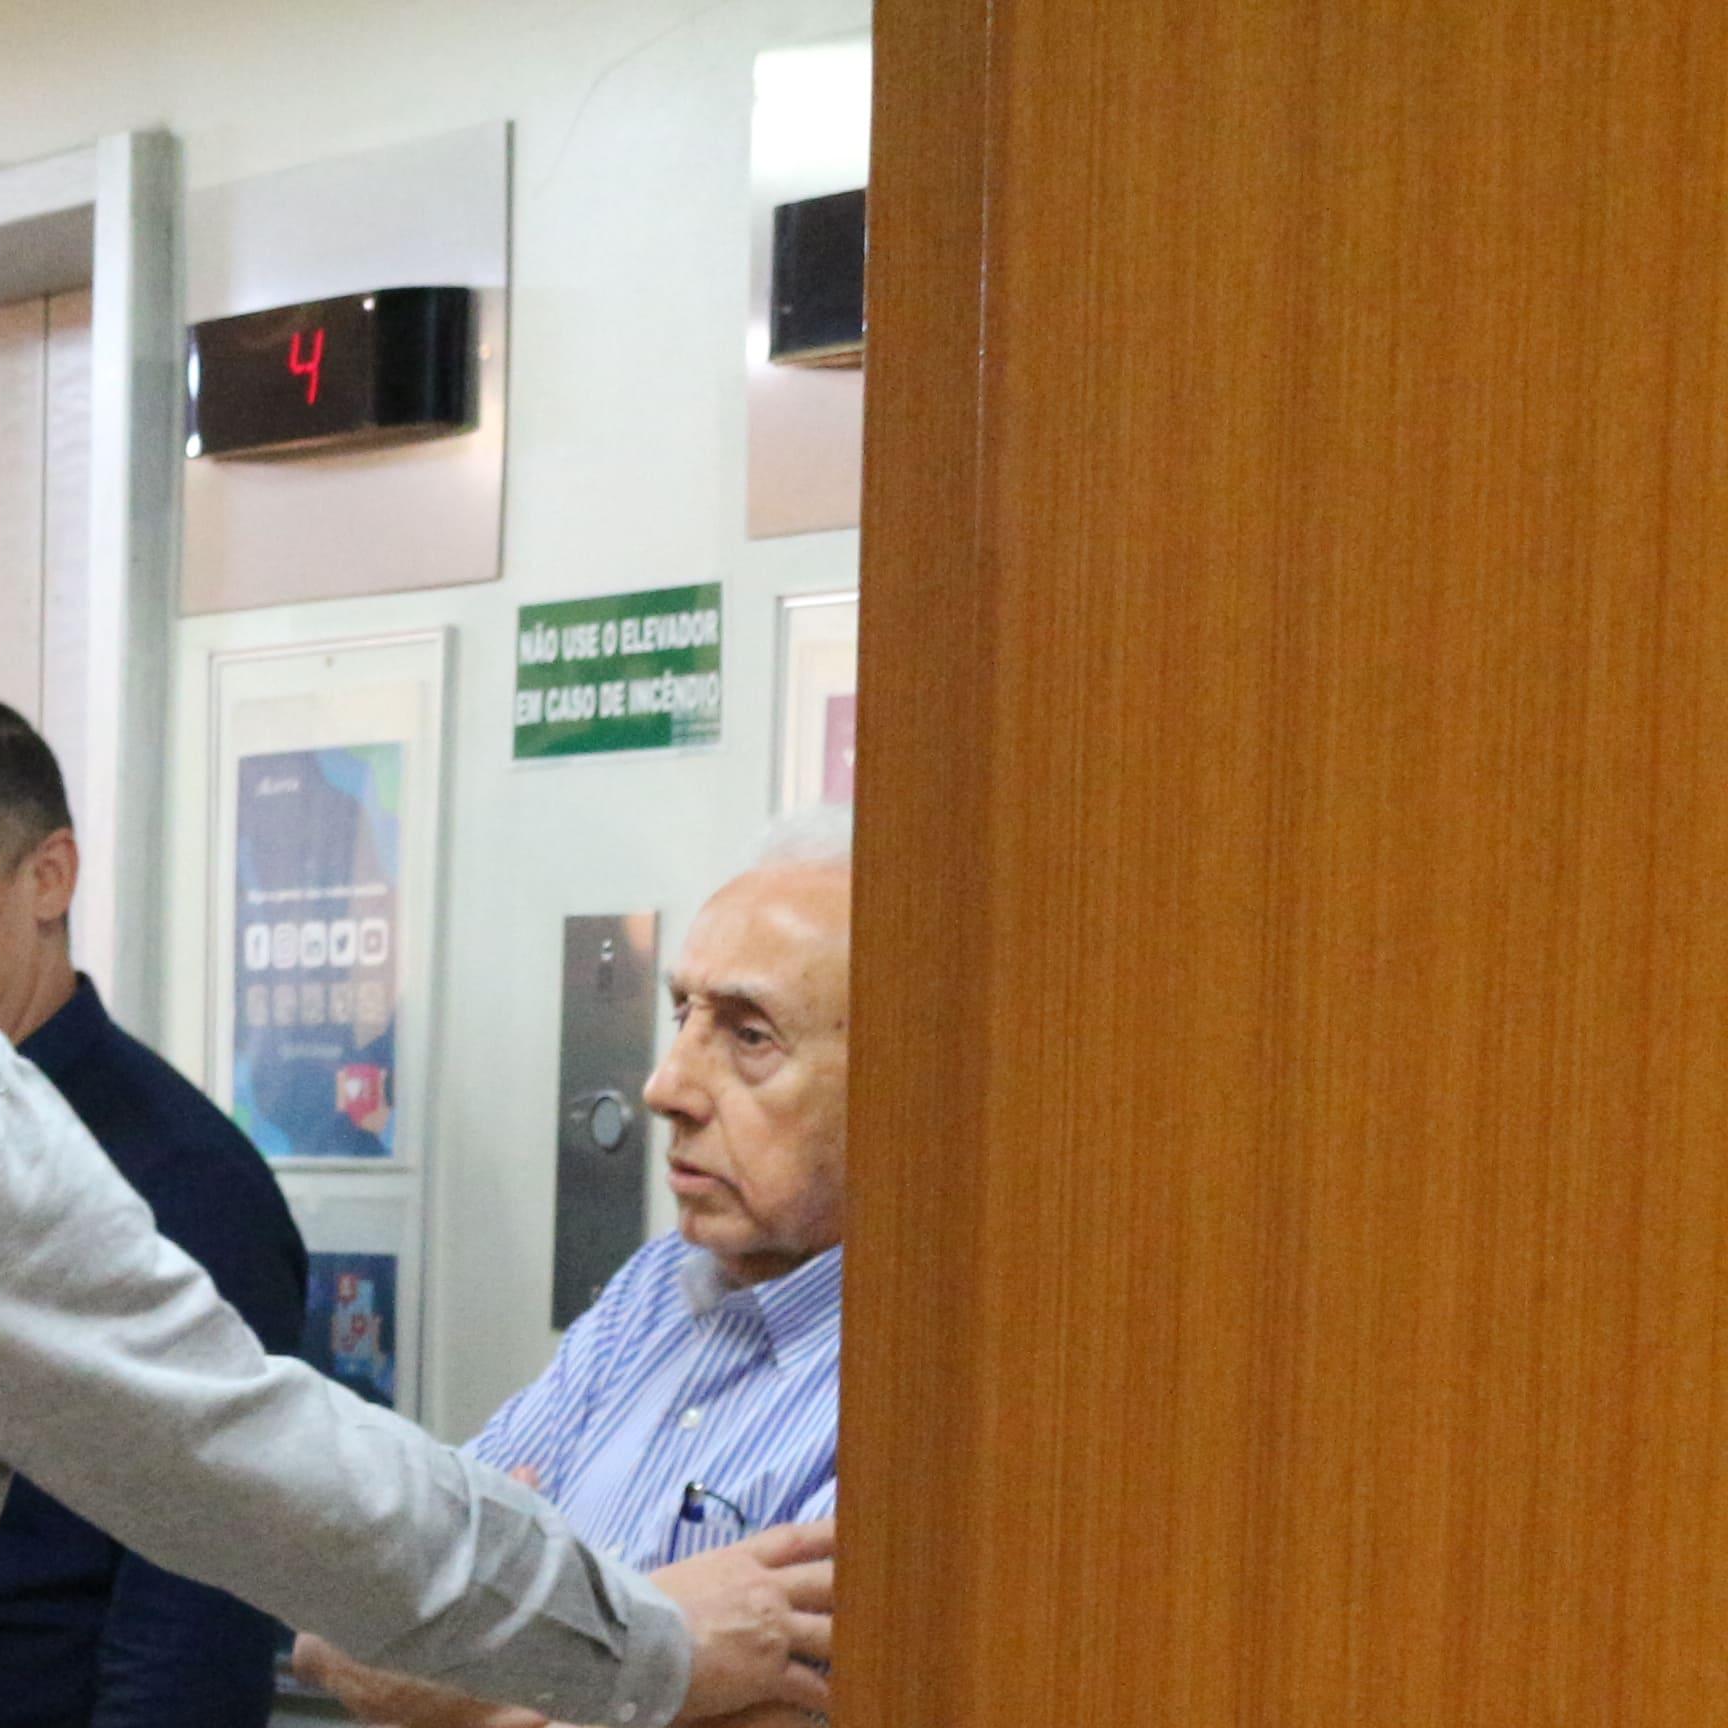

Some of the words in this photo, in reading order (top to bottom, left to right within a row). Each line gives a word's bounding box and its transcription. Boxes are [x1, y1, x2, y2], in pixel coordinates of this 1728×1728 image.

[288, 327, 326, 406] 4
[519, 623, 558, 665] NÃO
[562, 623, 599, 662] USE
[601, 620, 618, 657] O
[619, 609, 718, 655] ELEVADOR
[515, 689, 542, 726] EM
[545, 683, 597, 722] CASO
[599, 680, 626, 718] DE
[628, 670, 719, 715] INCÊNDIO
